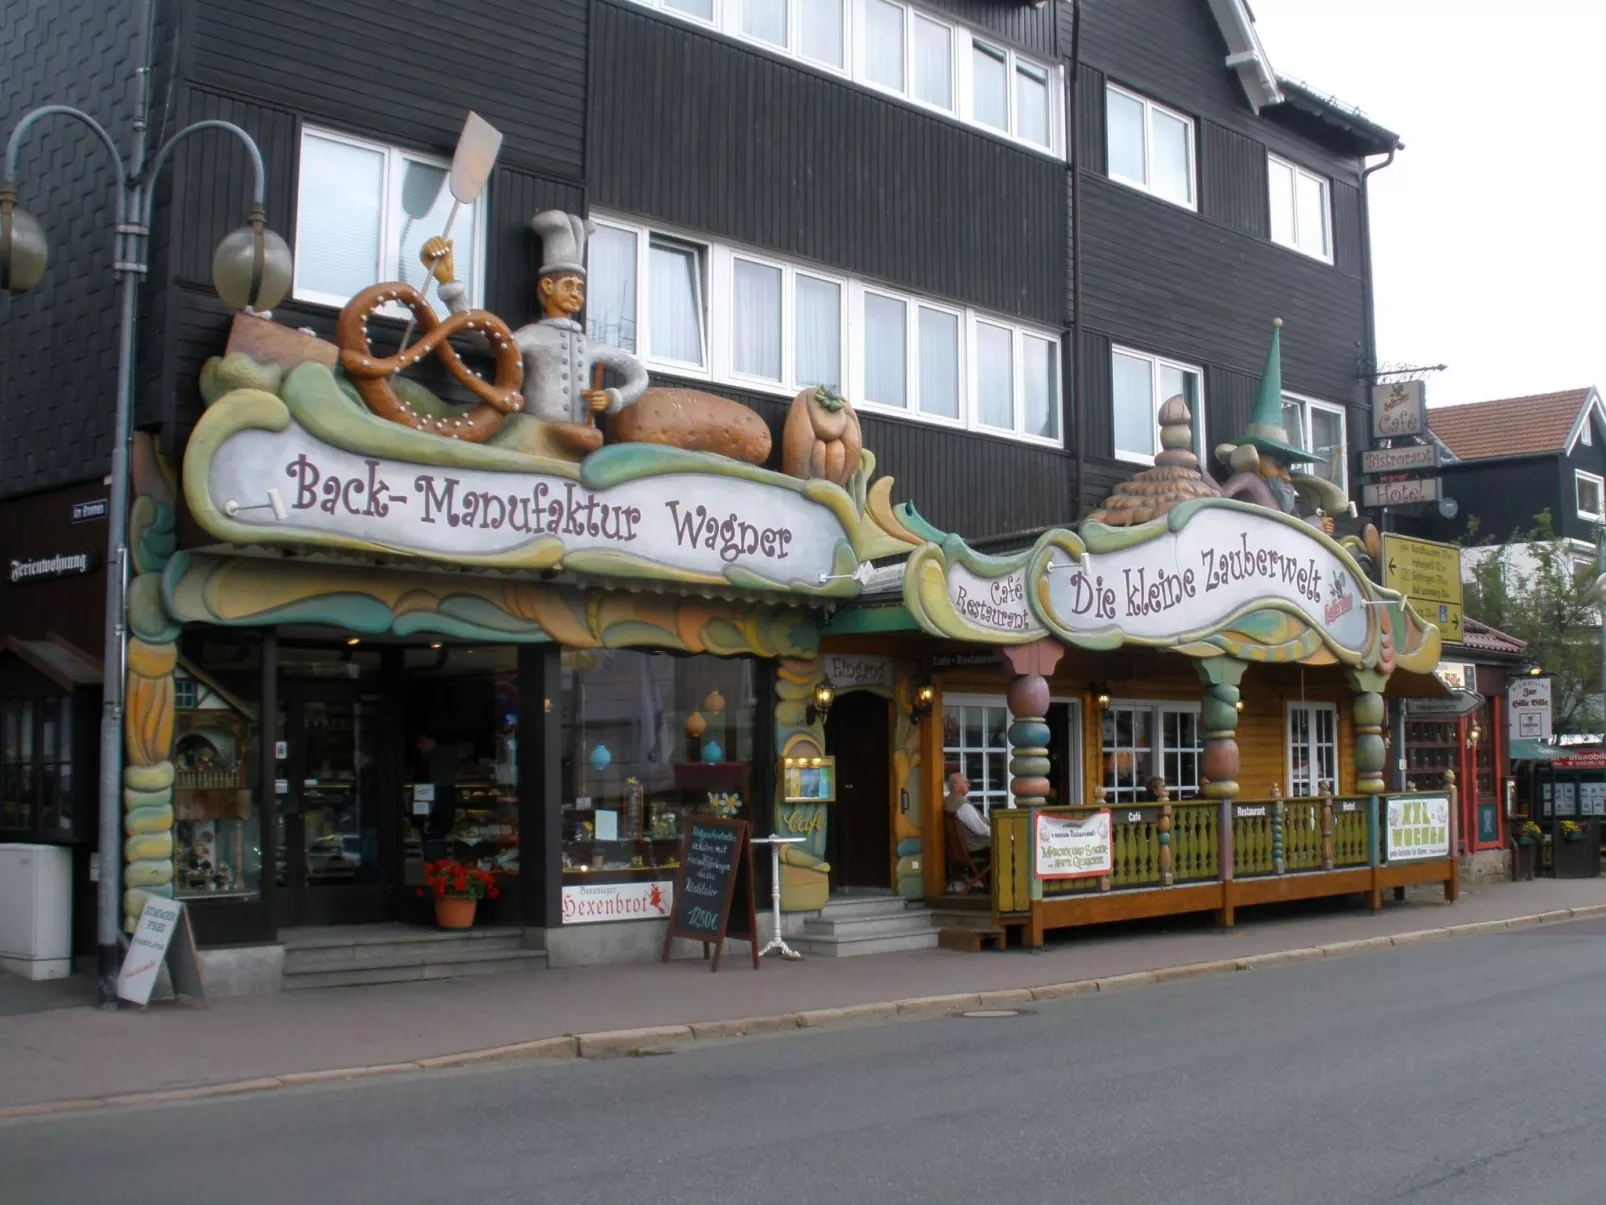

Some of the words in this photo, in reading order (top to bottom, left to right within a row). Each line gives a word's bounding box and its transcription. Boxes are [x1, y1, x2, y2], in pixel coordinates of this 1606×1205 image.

[1379, 411, 1417, 434] Café
[1375, 480, 1424, 504] Hotel
[286, 453, 407, 518] Back-
[414, 475, 641, 542] Manufaktur
[665, 500, 792, 562] Wagner
[11, 553, 87, 582] Ferienwohnung
[1070, 570, 1116, 619] Die
[1123, 567, 1196, 617] kleine
[1201, 532, 1321, 603] Zauberwelt
[991, 576, 1023, 606] Café
[956, 585, 1029, 630] Restaurant
[1128, 812, 1141, 822] Café
[1237, 806, 1265, 816] Restaurant
[562, 894, 648, 918] Hexenbrot
